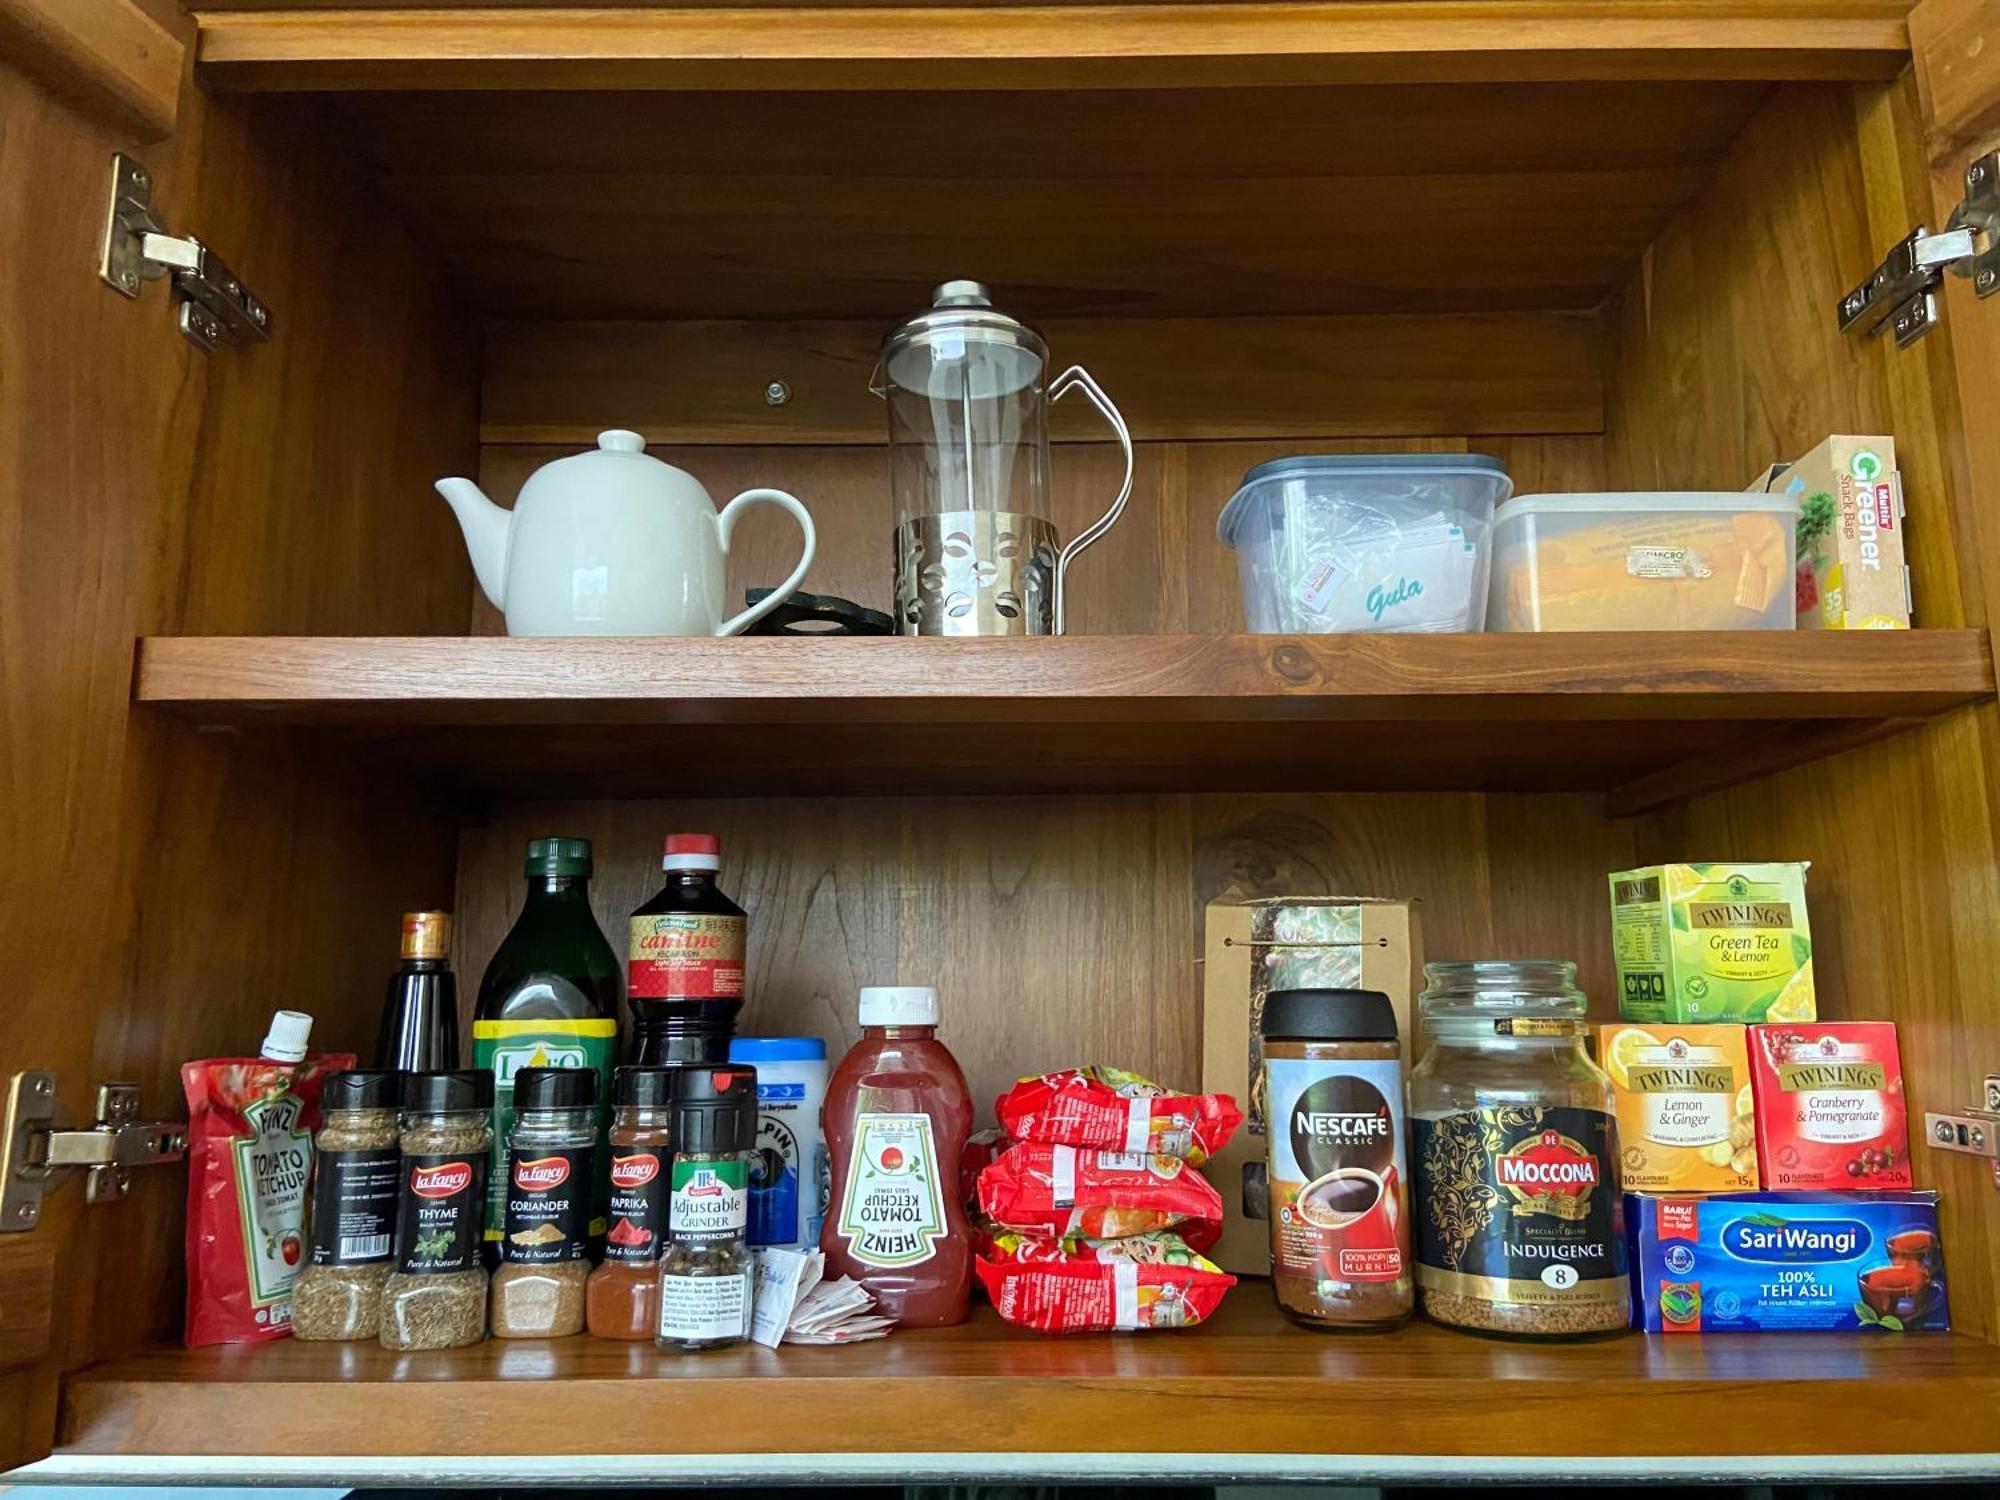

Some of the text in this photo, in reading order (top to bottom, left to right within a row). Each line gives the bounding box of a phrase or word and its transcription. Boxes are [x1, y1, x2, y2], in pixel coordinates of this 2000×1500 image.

[1840, 474, 1856, 540] Snack Bags
[1851, 451, 1880, 571] Greener
[1877, 488, 1891, 526] Multix
[1366, 577, 1424, 622] Gula
[1697, 904, 1785, 926] TWININGS
[1710, 935, 1779, 949] Green Tea
[1721, 950, 1770, 962] & Lemon
[1635, 1068, 1726, 1090] TWININGS
[1788, 1066, 1878, 1089] TWININGS
[1664, 1098, 1702, 1111] Lemon
[1809, 1096, 1865, 1109] Cranberry
[1659, 1113, 1710, 1128] & Ginger
[1796, 1111, 1880, 1125] & Pomegranate
[1317, 1136, 1374, 1145] CLASSIC
[530, 1165, 566, 1183] Fancy
[621, 1162, 654, 1181] Fancy
[1503, 1159, 1595, 1182] MOCCONA
[430, 1172, 467, 1190] Fancy
[1623, 1175, 1636, 1185] 10
[1777, 1173, 1791, 1184] 10
[510, 1200, 570, 1212] CORIANDER
[611, 1197, 649, 1209] PAPRIKA
[865, 1194, 919, 1206] KETCHUP
[419, 1207, 459, 1219] THYME
[673, 1197, 741, 1217] Adjustable
[1663, 1205, 1693, 1214] BARU!
[861, 1207, 922, 1222] TOMATO
[680, 1217, 730, 1228] GRINDER
[693, 1231, 736, 1240] PEPPERCORNS
[1739, 1227, 1857, 1254] SariWangi
[864, 1232, 918, 1254] HEINZ
[533, 1248, 563, 1258] Natural
[623, 1246, 652, 1256] Natural
[1503, 1240, 1605, 1260] INDULGENCE
[432, 1256, 464, 1268] Natural
[1344, 1253, 1386, 1262] 100% KOPI
[1344, 1263, 1386, 1272] MURNI
[1555, 1269, 1566, 1284] 8
[1777, 1271, 1816, 1283] 100%
[1760, 1284, 1833, 1297] TEH ASLI
